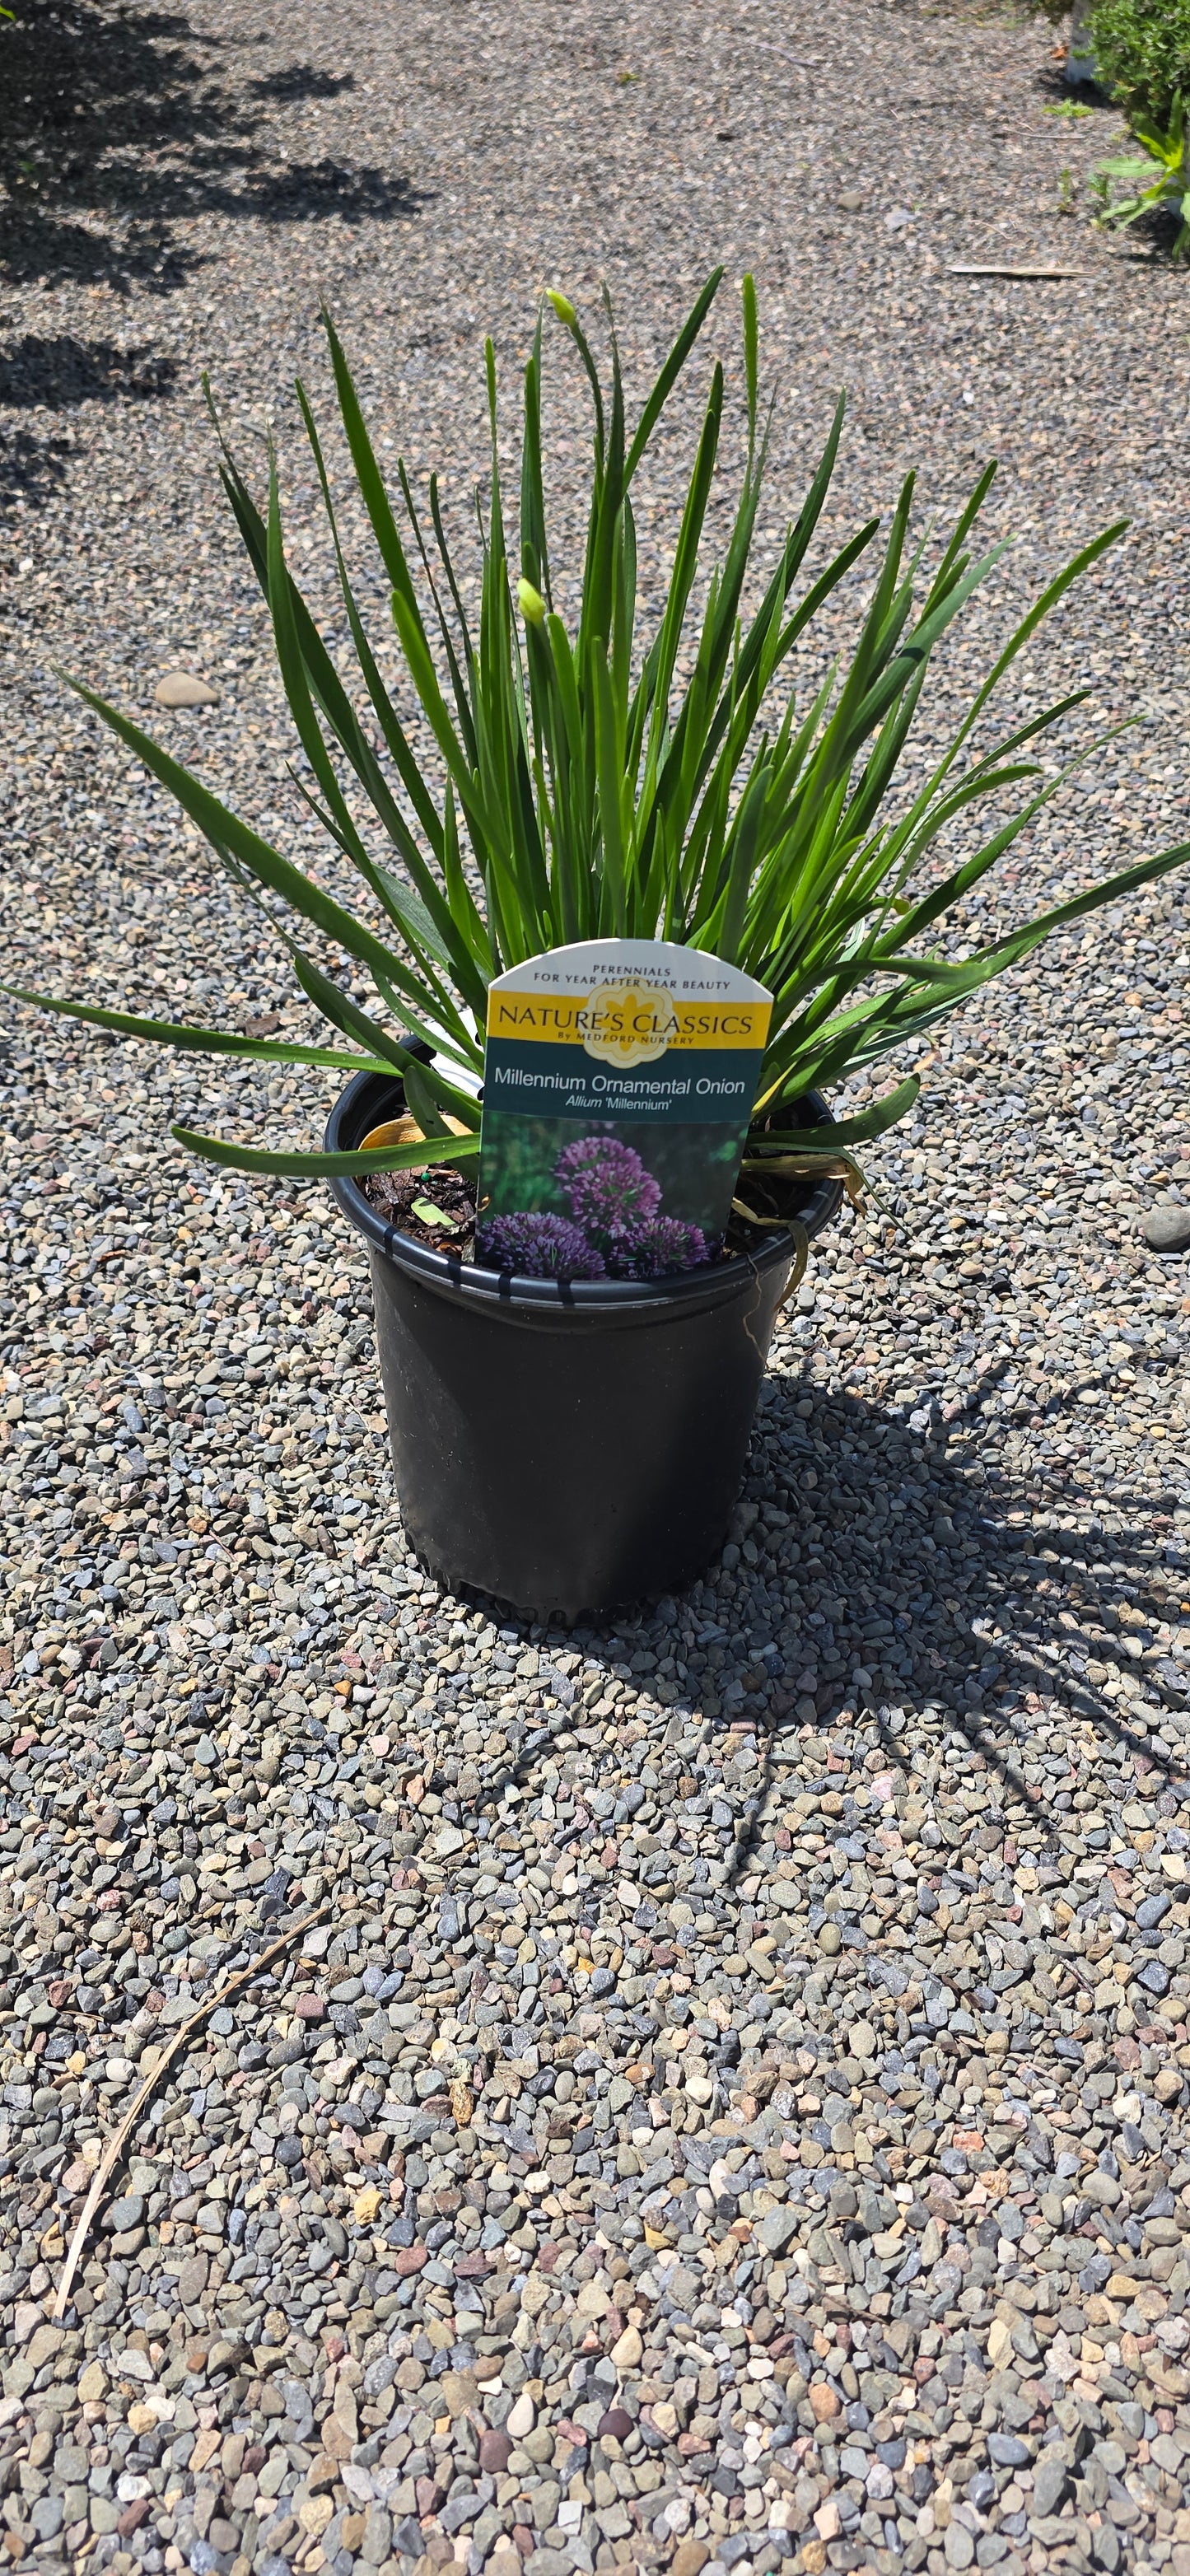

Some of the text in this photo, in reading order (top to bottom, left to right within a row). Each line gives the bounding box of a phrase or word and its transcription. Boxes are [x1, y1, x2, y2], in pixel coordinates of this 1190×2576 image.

[593, 964, 671, 977] PERENNIALS
[534, 973, 730, 990] FOR YEAR AFTER YEAR BEAUTY
[498, 1005, 754, 1034] NATURE'S CLASSICS
[576, 1034, 636, 1043] MEDFORD
[641, 1035, 694, 1045] NURSERY
[494, 1066, 745, 1095] Millennium Ornamental Onion
[565, 1094, 673, 1111] Allium 'Millennium'
